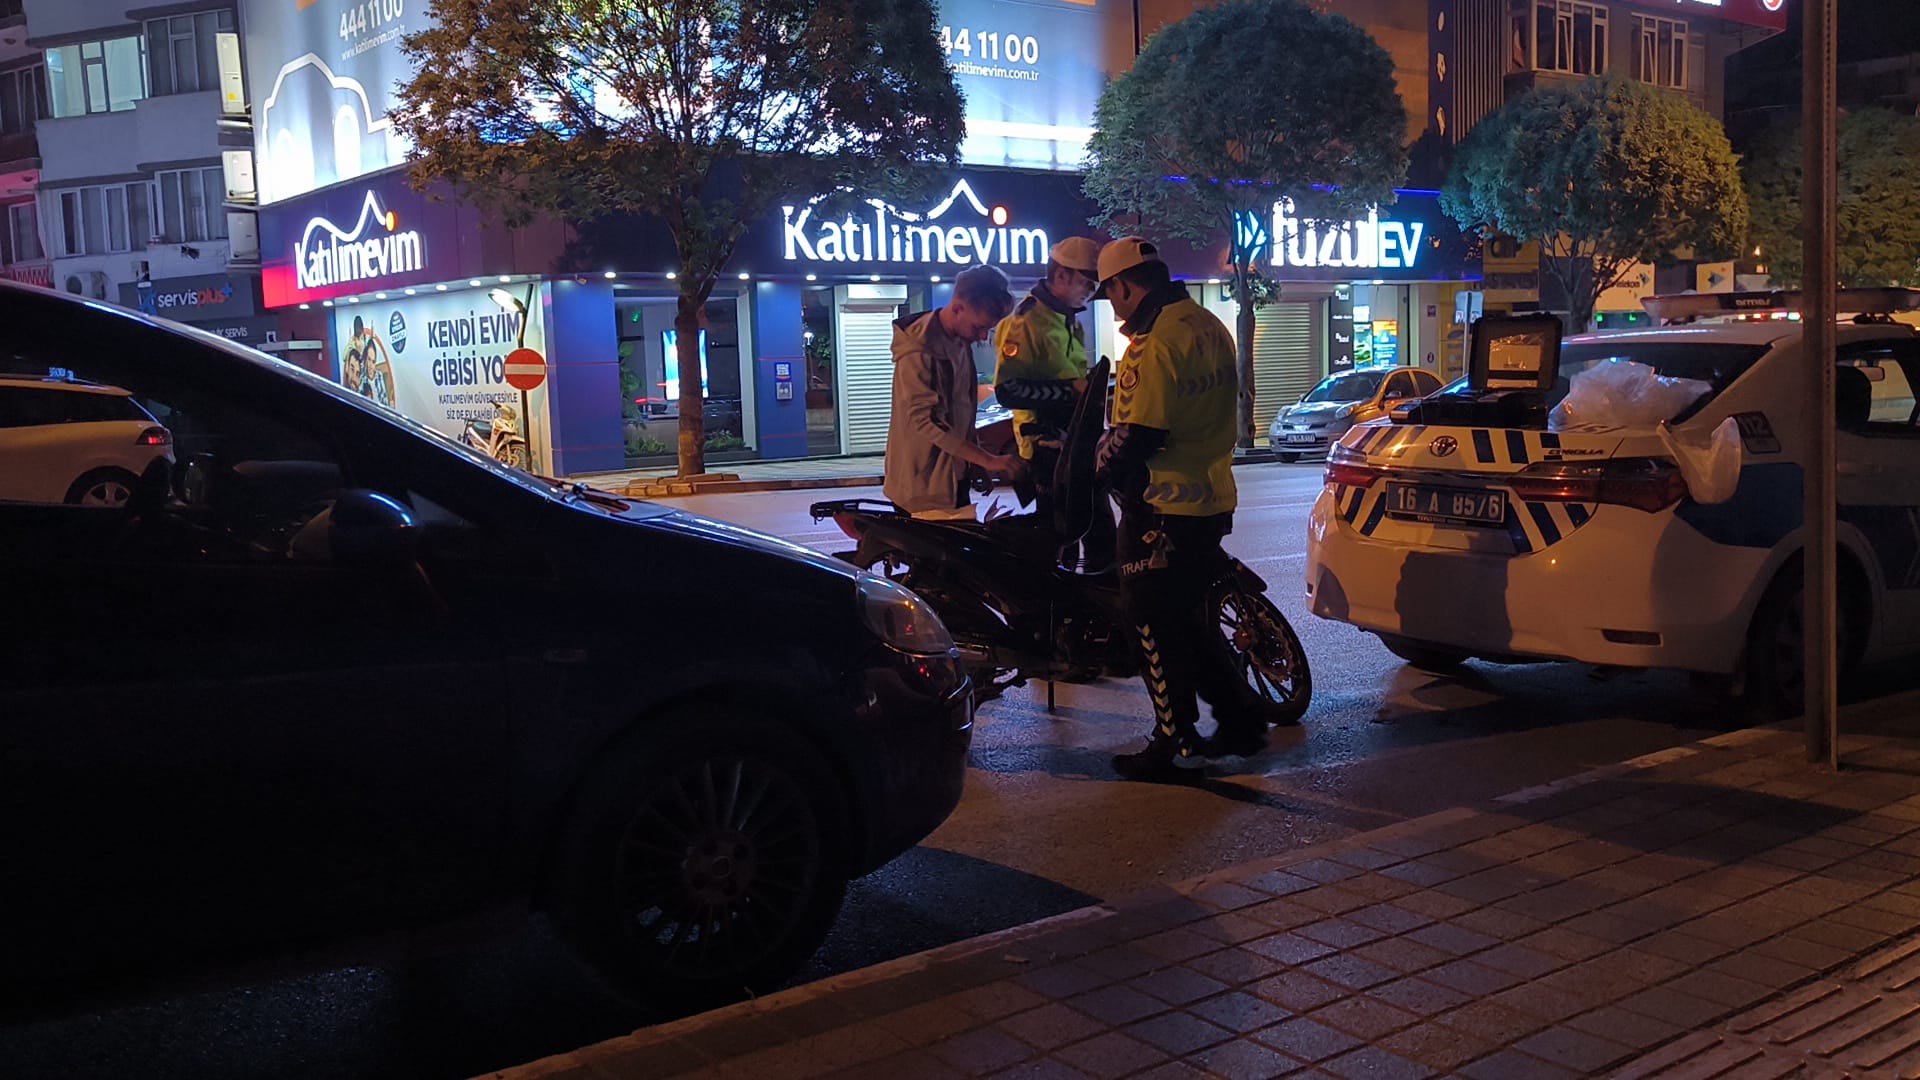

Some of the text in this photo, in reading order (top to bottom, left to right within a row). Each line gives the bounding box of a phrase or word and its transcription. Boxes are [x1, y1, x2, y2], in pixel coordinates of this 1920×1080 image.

[340, 0, 404, 41] 444 11 00
[937, 25, 1039, 65] 44 11 00
[946, 60, 1039, 80] atilimevim.com.tr
[427, 309, 476, 349] KENDİ
[480, 305, 520, 345] EVİM
[432, 349, 509, 387] GİBİSİ YO
[1397, 486, 1418, 511] 16
[1428, 491, 1439, 514] A
[1121, 558, 1151, 577] TRAF
